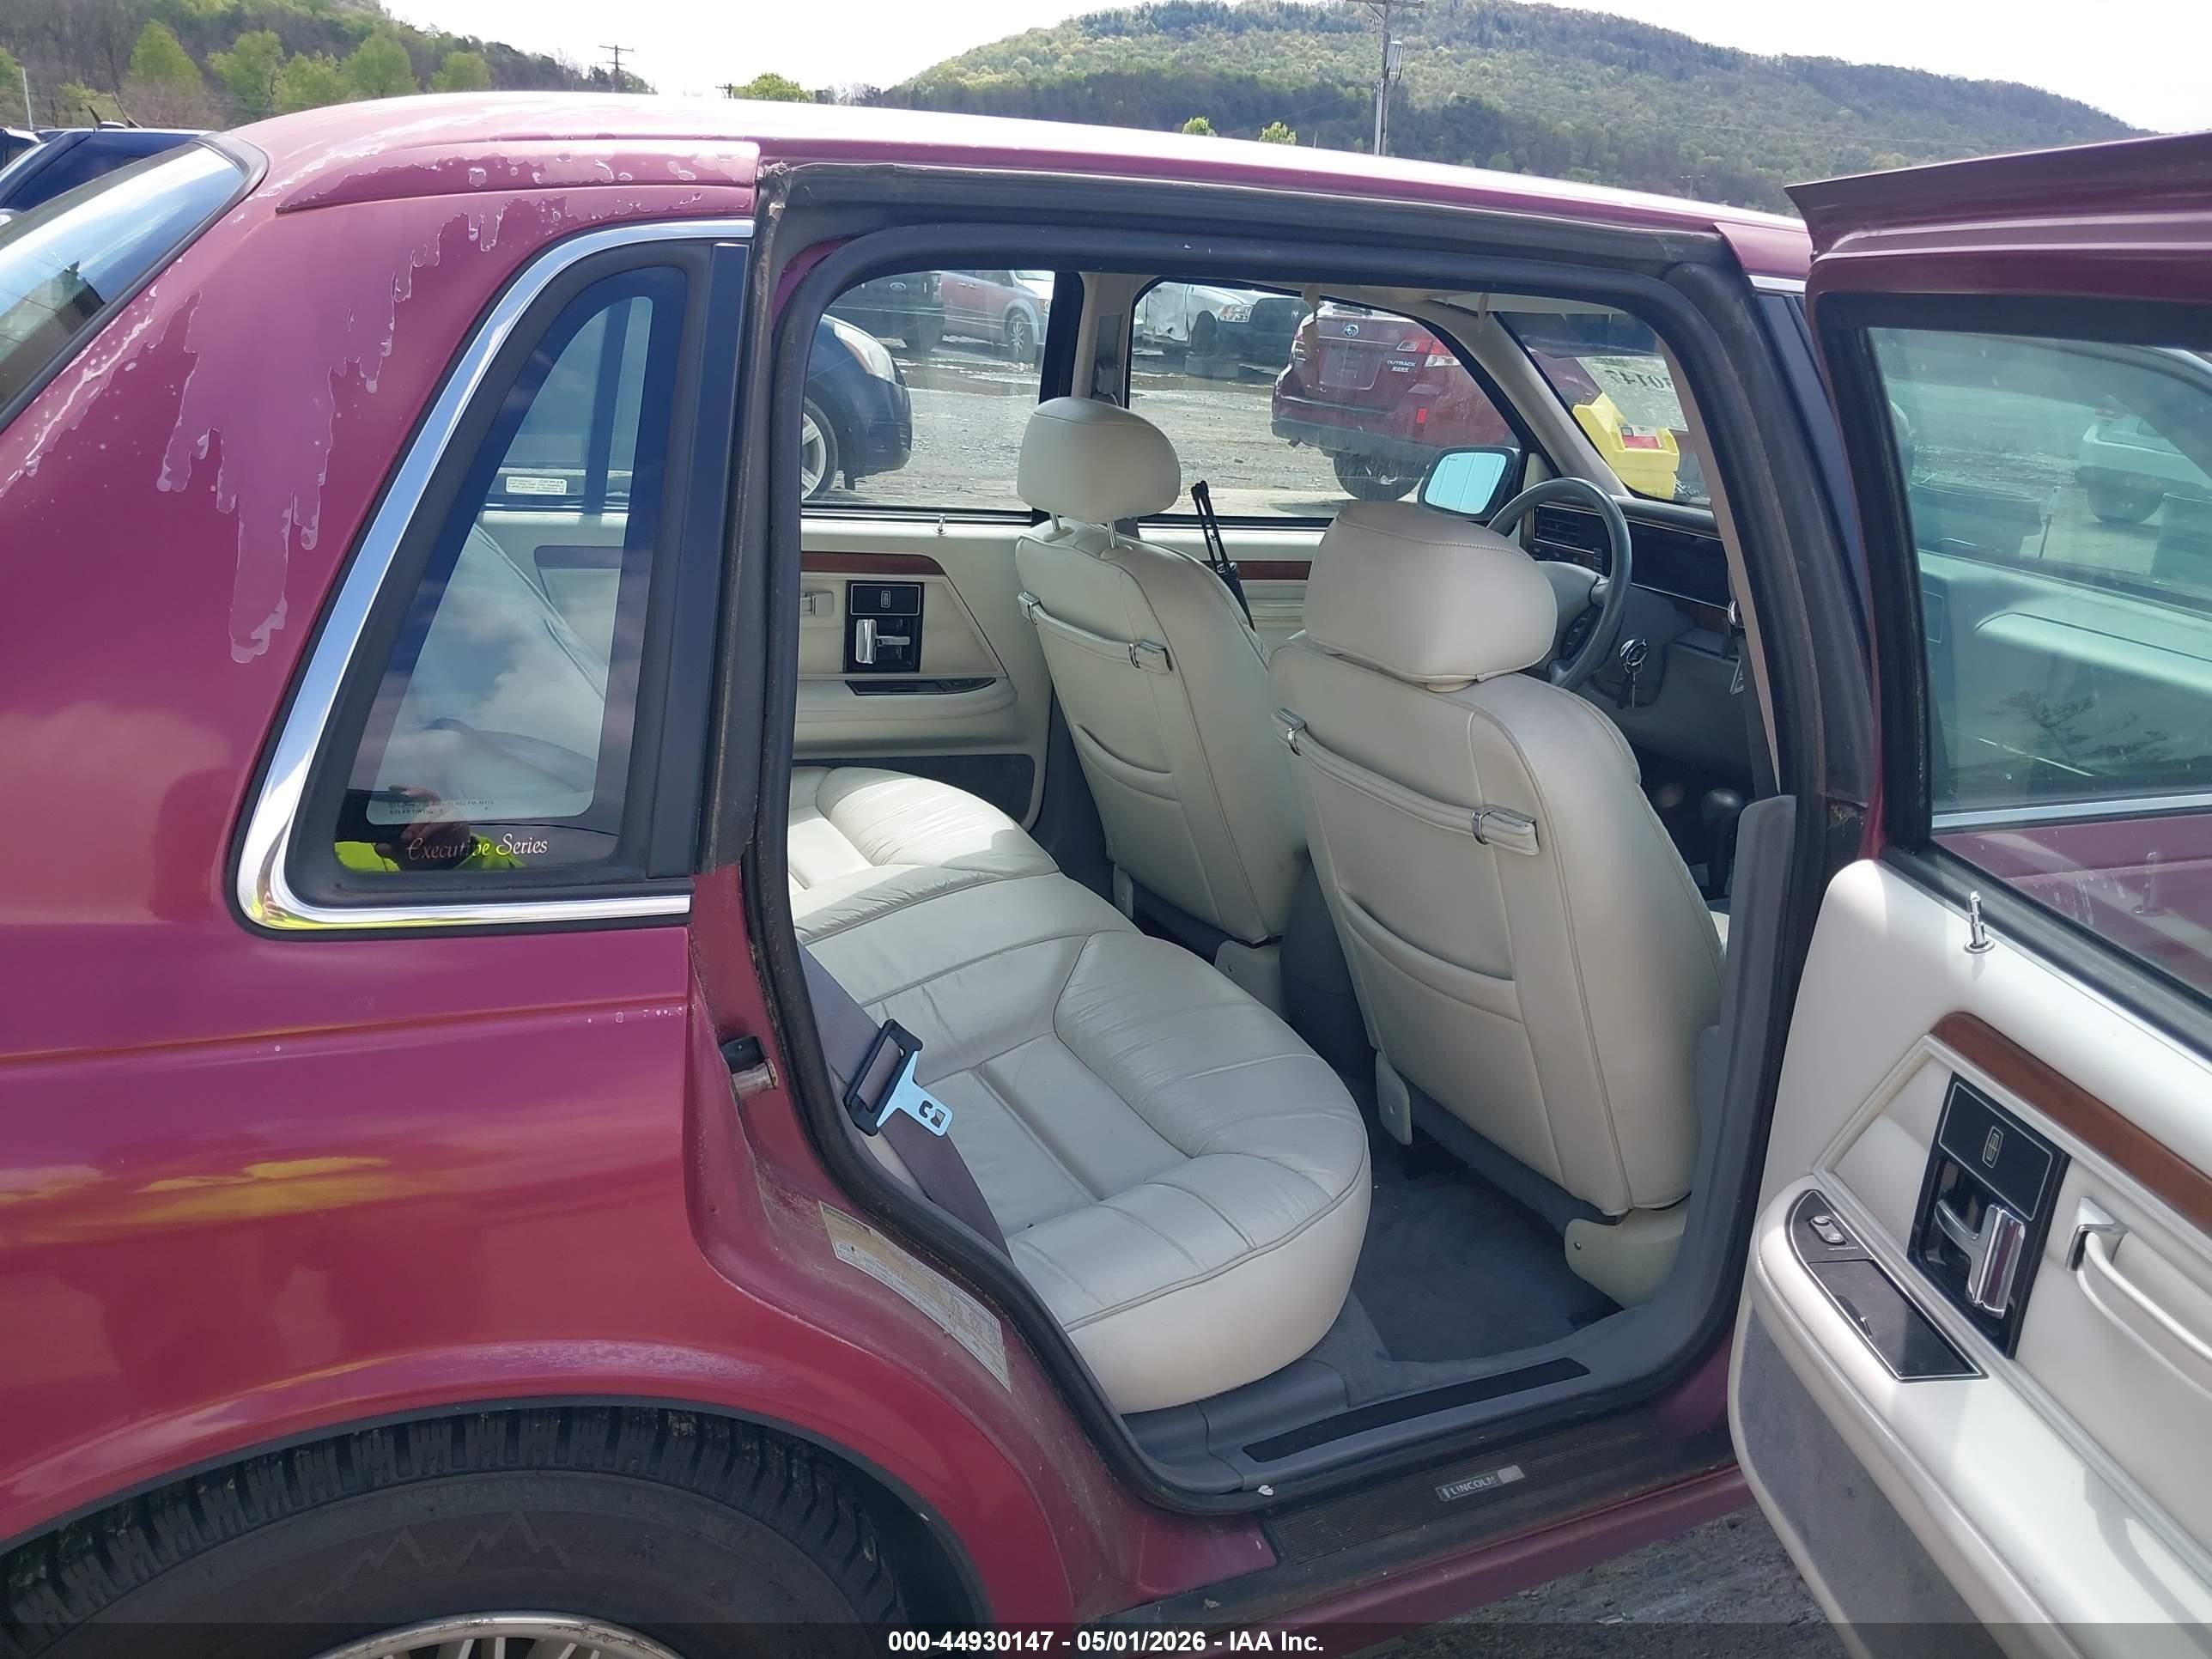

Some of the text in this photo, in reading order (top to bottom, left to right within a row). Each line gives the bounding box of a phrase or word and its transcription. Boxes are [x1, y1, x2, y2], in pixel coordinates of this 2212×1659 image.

[407, 833, 548, 861] Executive Series
[1449, 1475, 1497, 1494] LINCOLN
